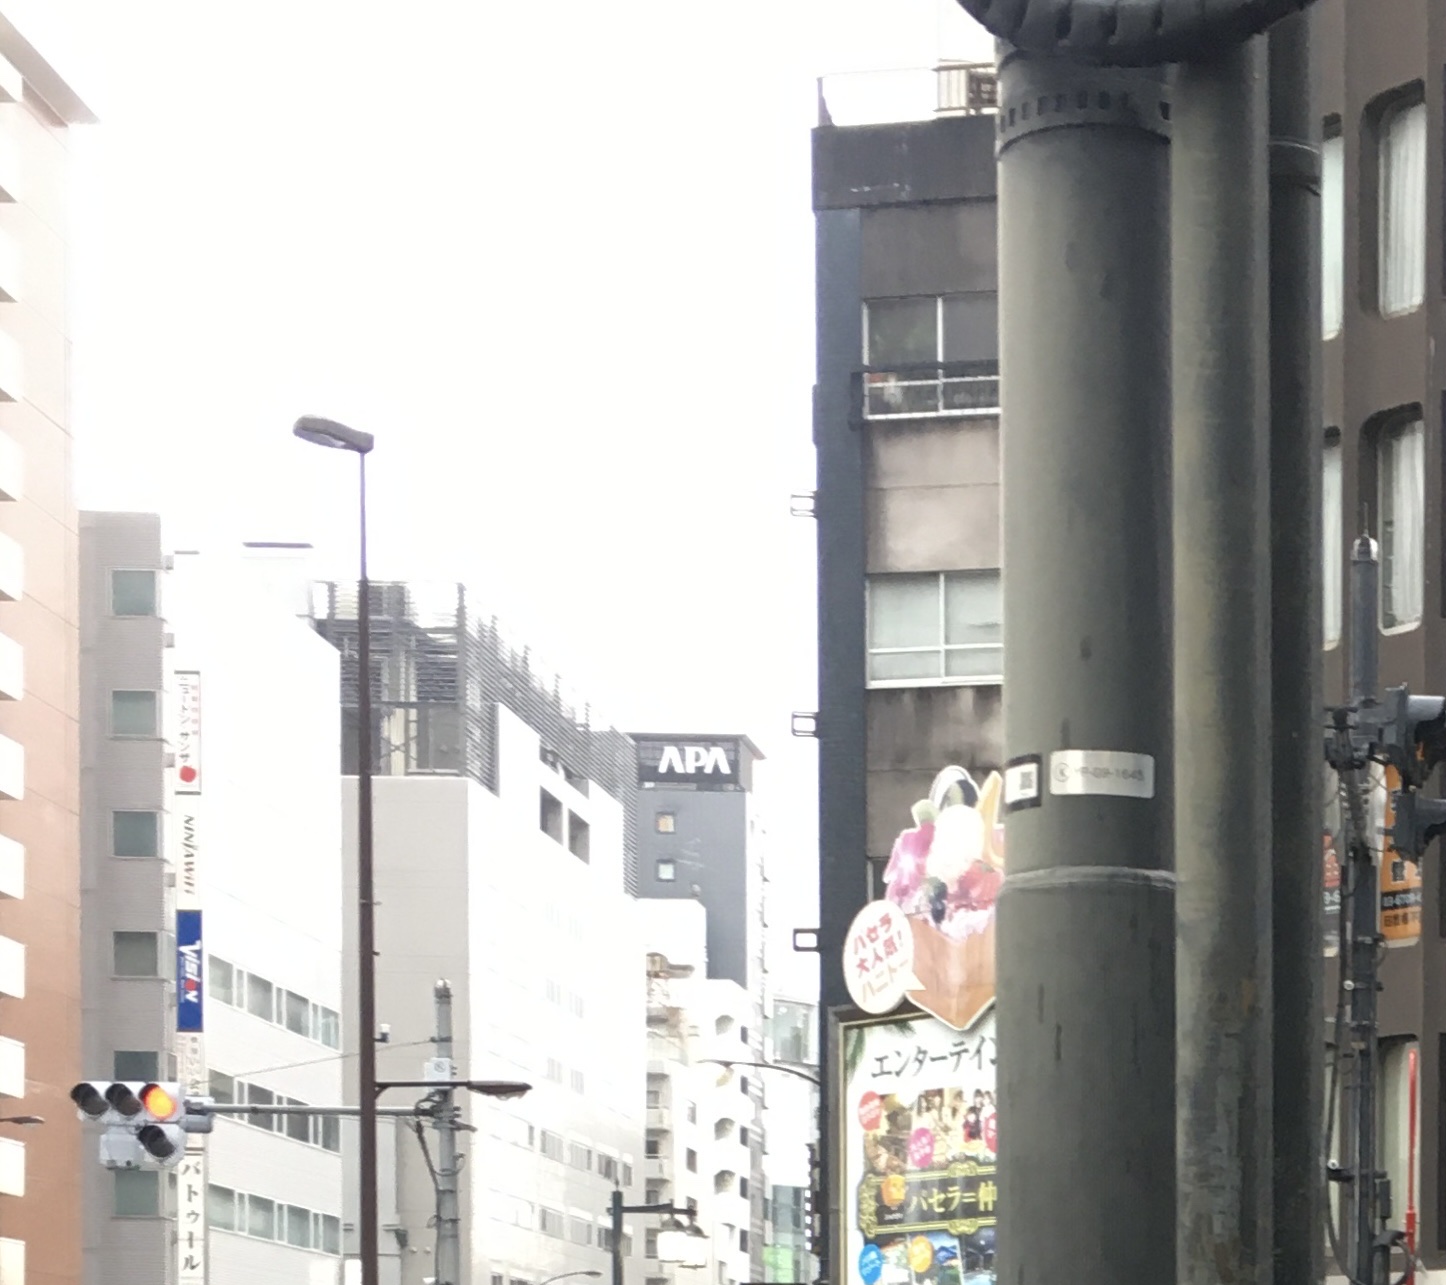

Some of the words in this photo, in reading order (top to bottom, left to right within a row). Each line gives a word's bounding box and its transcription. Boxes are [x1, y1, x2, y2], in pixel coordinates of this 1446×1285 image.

[658, 746, 731, 774] APA
[182, 1161, 201, 1271] バトゥール
